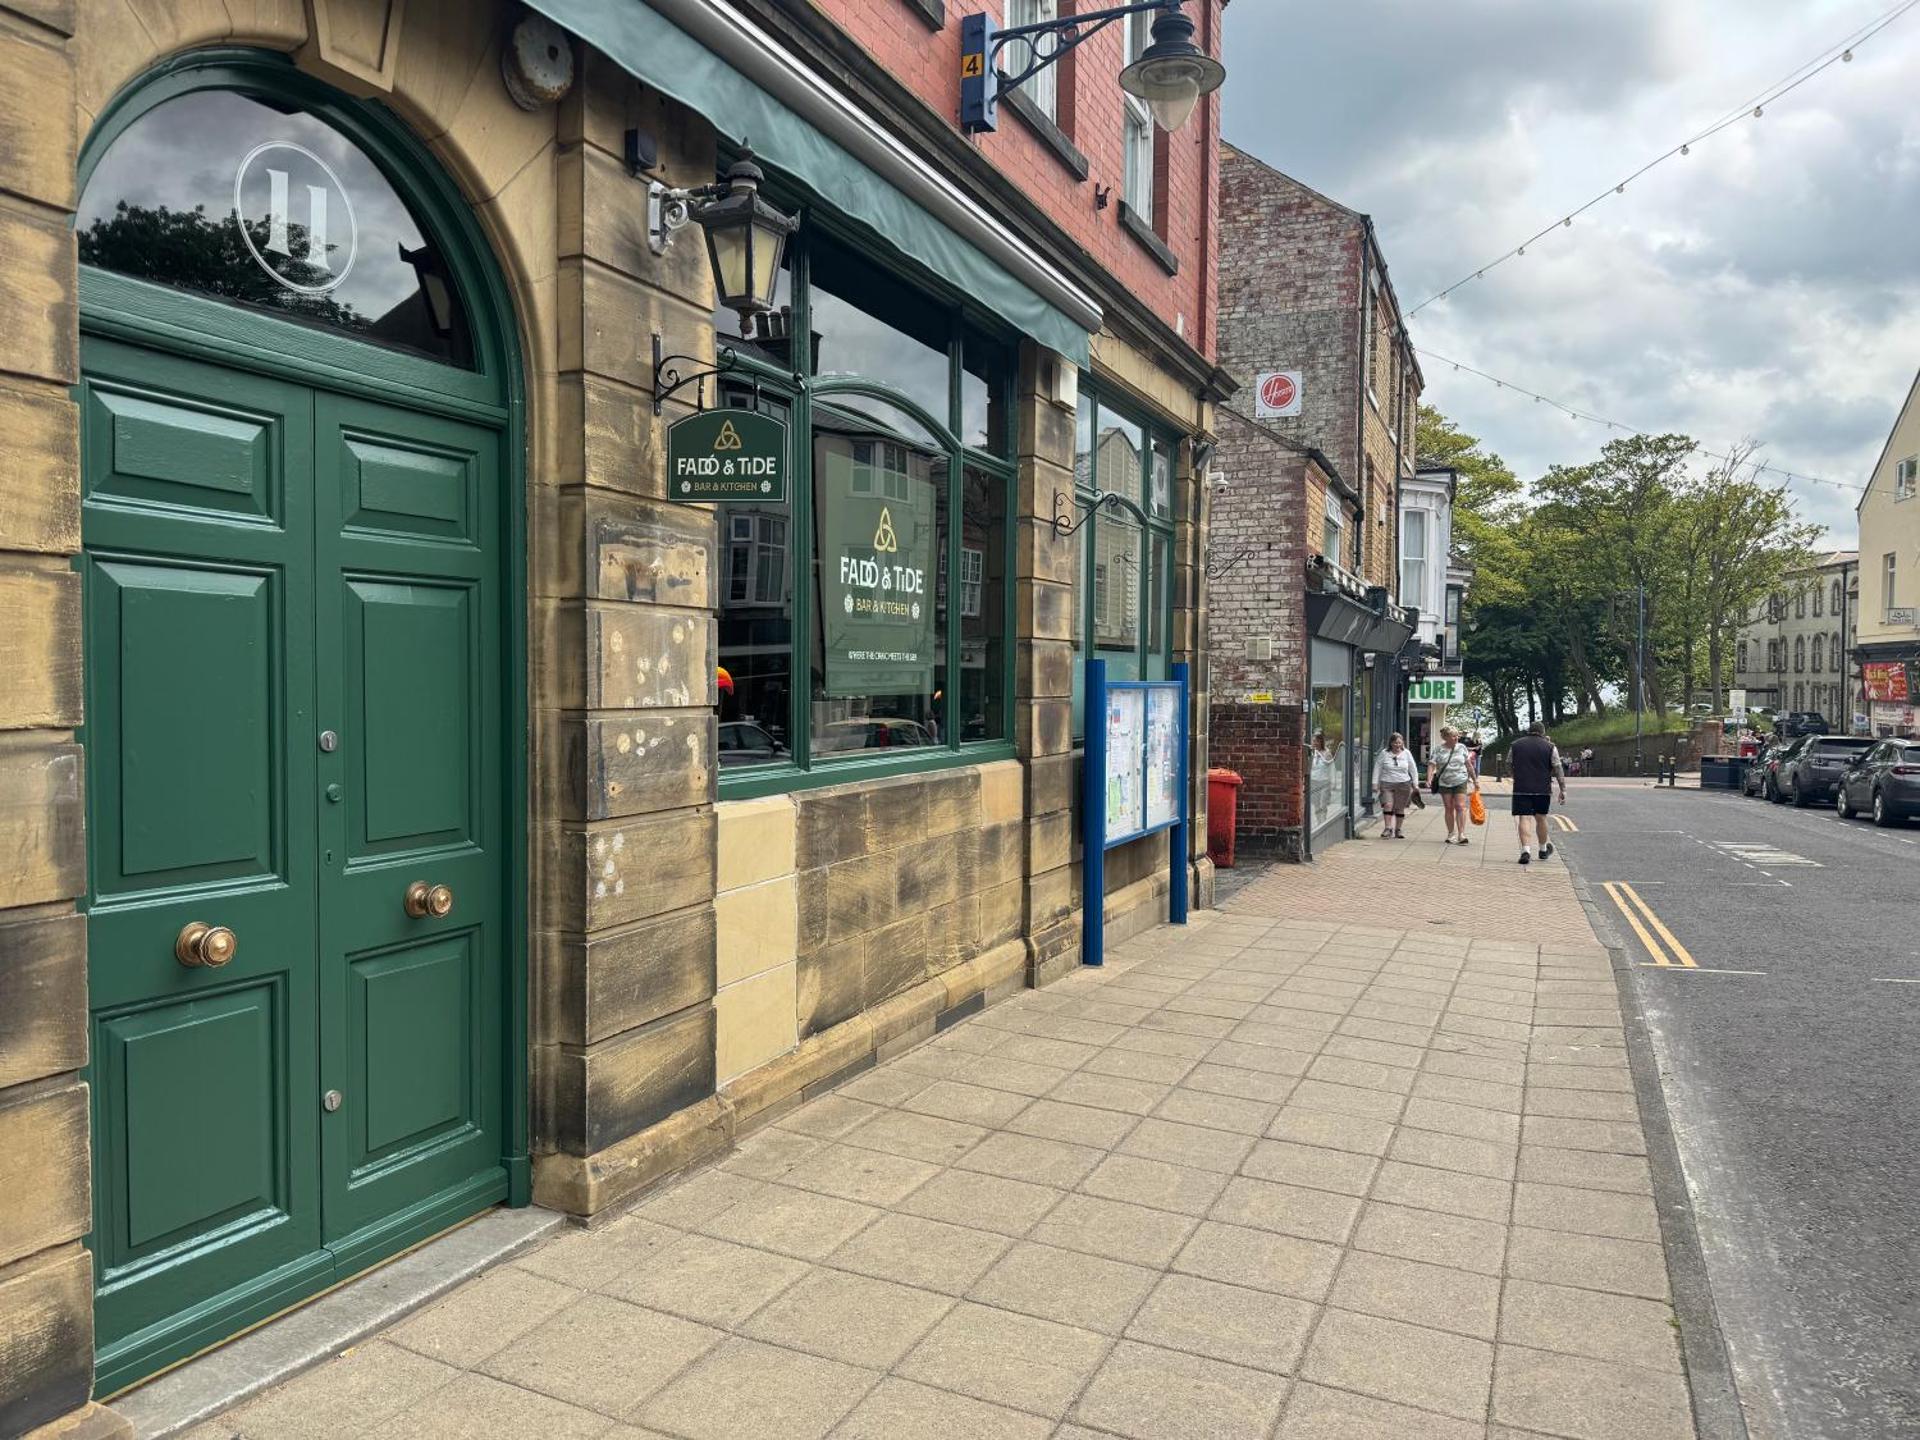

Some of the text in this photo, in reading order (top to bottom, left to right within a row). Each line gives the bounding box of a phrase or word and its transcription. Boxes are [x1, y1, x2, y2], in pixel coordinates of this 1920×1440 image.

[965, 55, 979, 75] 4
[264, 168, 331, 271] 11
[677, 454, 720, 476] FADÓ
[723, 459, 735, 475] &
[694, 482, 757, 491] BAR & KITCHEN
[840, 556, 879, 588] FADÓ
[881, 566, 891, 590] &
[855, 598, 910, 615] BAR & KITCHEN
